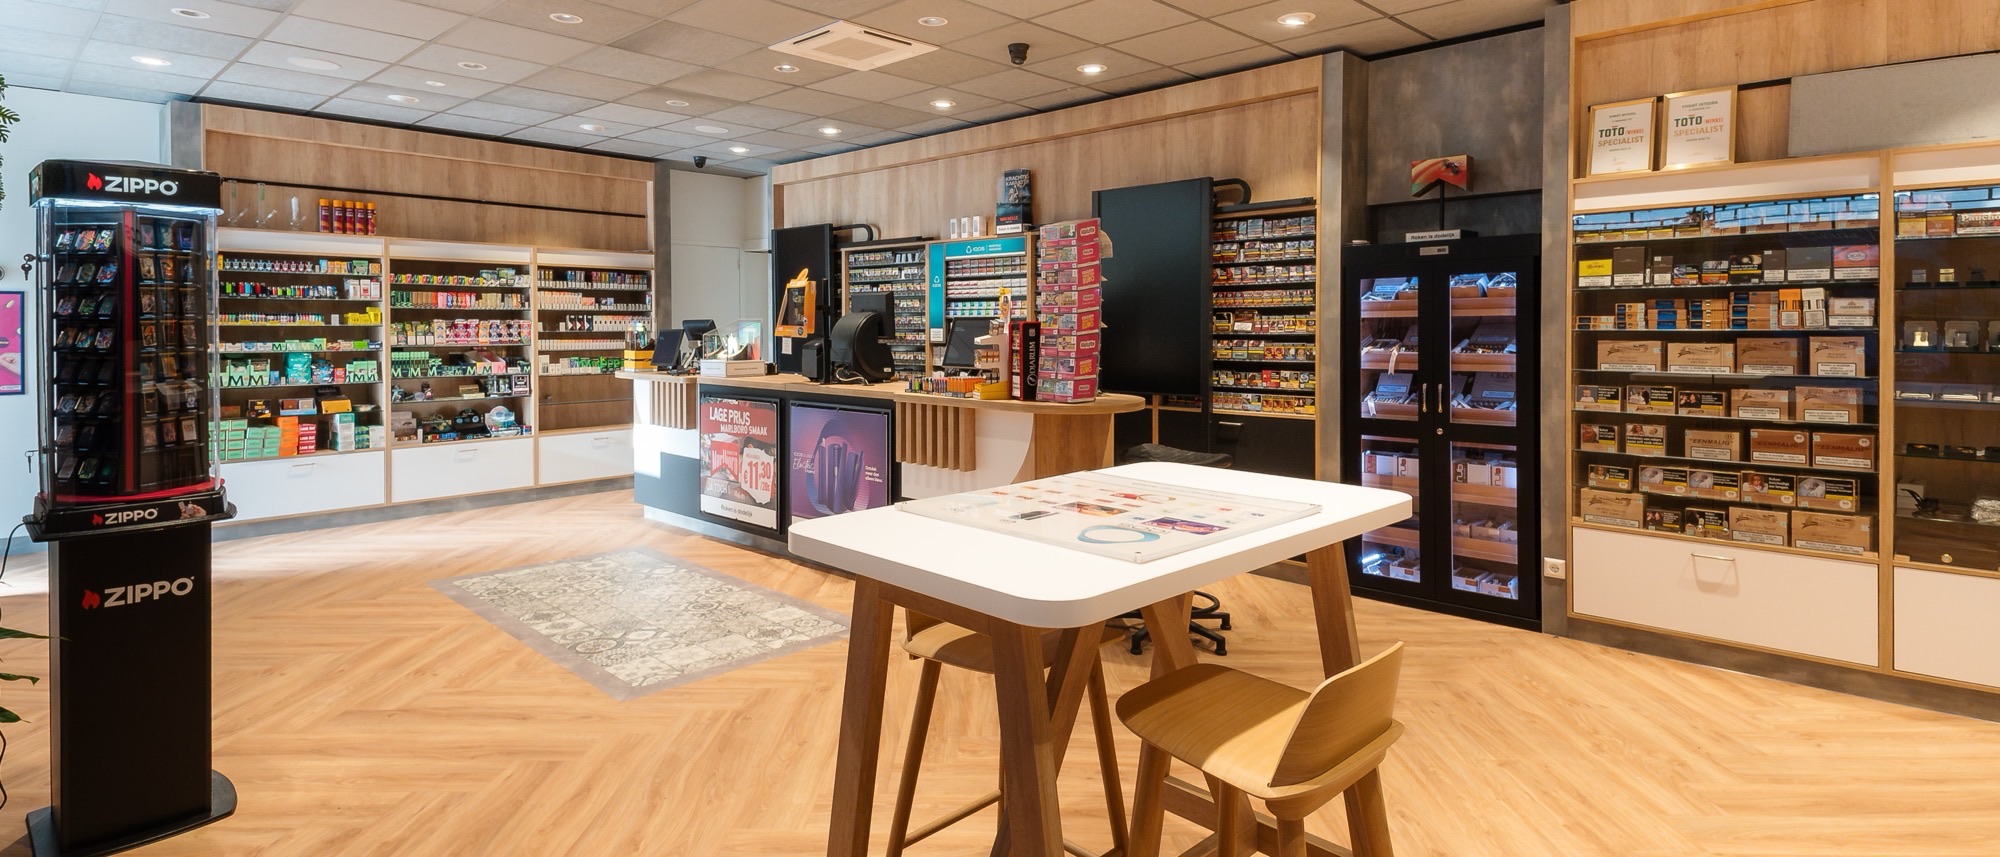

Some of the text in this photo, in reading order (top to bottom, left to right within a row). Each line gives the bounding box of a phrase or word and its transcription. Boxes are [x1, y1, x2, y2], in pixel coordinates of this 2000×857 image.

[1674, 114, 1703, 128] TOTO
[1598, 126, 1625, 138] TOTO
[1674, 125, 1724, 138] SPECIALIST
[1598, 136, 1644, 148] SPECIALIST
[104, 176, 178, 196] ZIPPO
[710, 407, 751, 426] LAGE PRIJS
[720, 424, 768, 436] MARLBORO SMAAK
[105, 508, 158, 525] ZIPPO
[104, 577, 194, 608] ZIPPO
